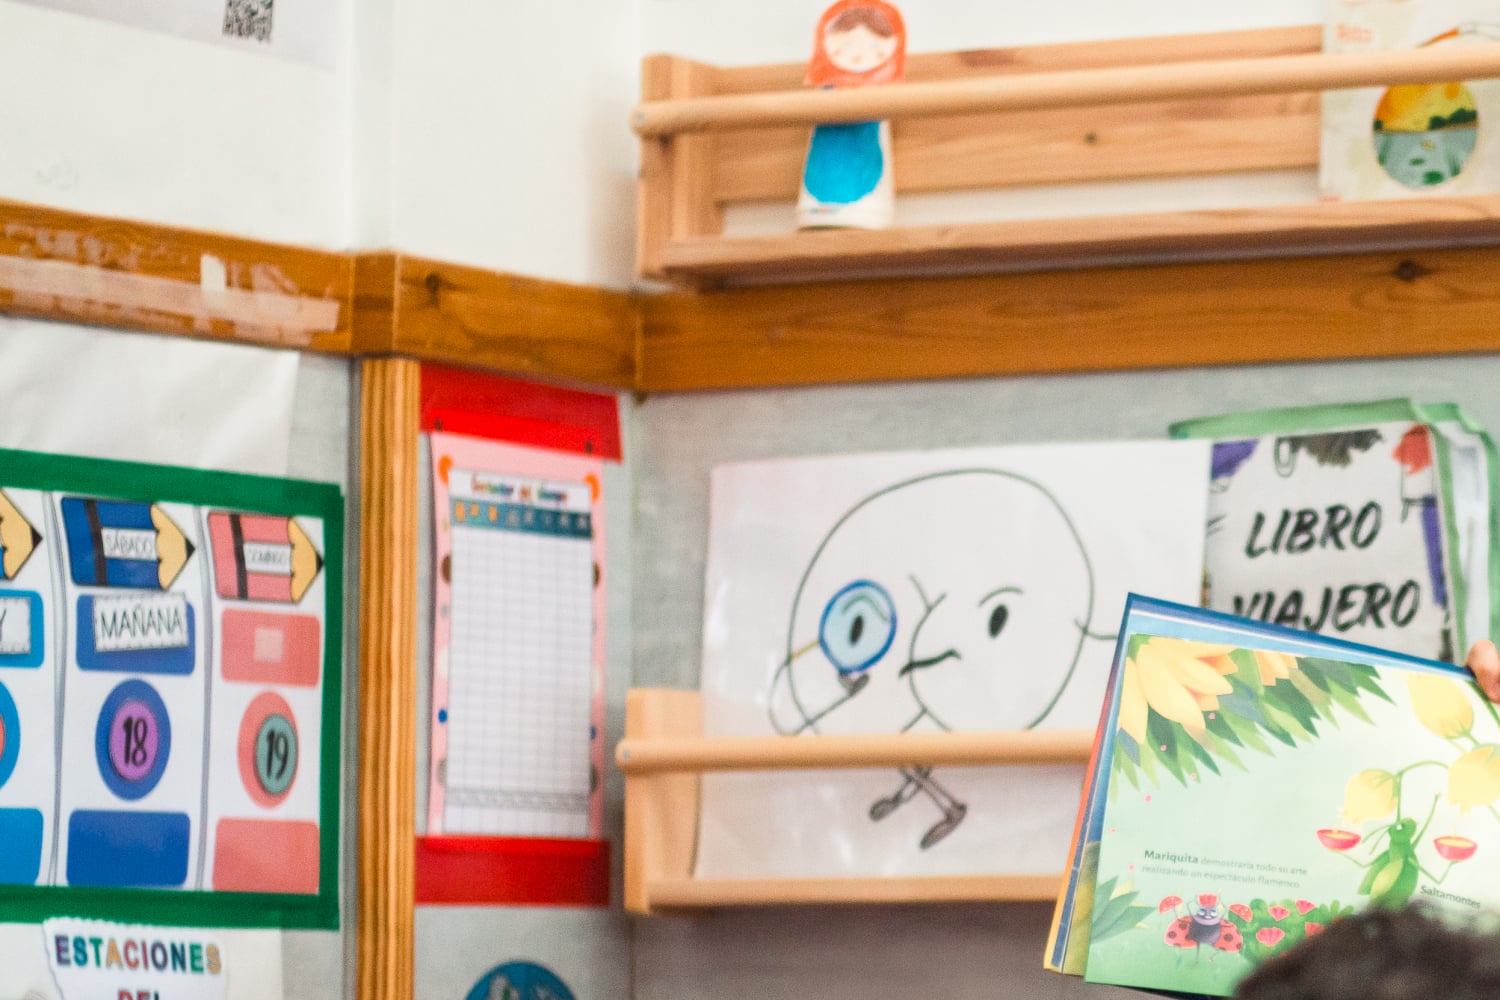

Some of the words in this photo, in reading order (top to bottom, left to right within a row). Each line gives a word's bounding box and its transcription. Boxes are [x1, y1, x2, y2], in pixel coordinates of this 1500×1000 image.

[1245, 500, 1382, 559] LIBRO
[100, 604, 184, 638] MAÑANA
[1233, 579, 1420, 633] VIAJERO
[123, 715, 148, 768] 18
[267, 729, 289, 780] 19
[1144, 850, 1199, 864] Mariquita
[1420, 885, 1481, 908] Saltamontes
[55, 934, 222, 974] ESTACIONES
